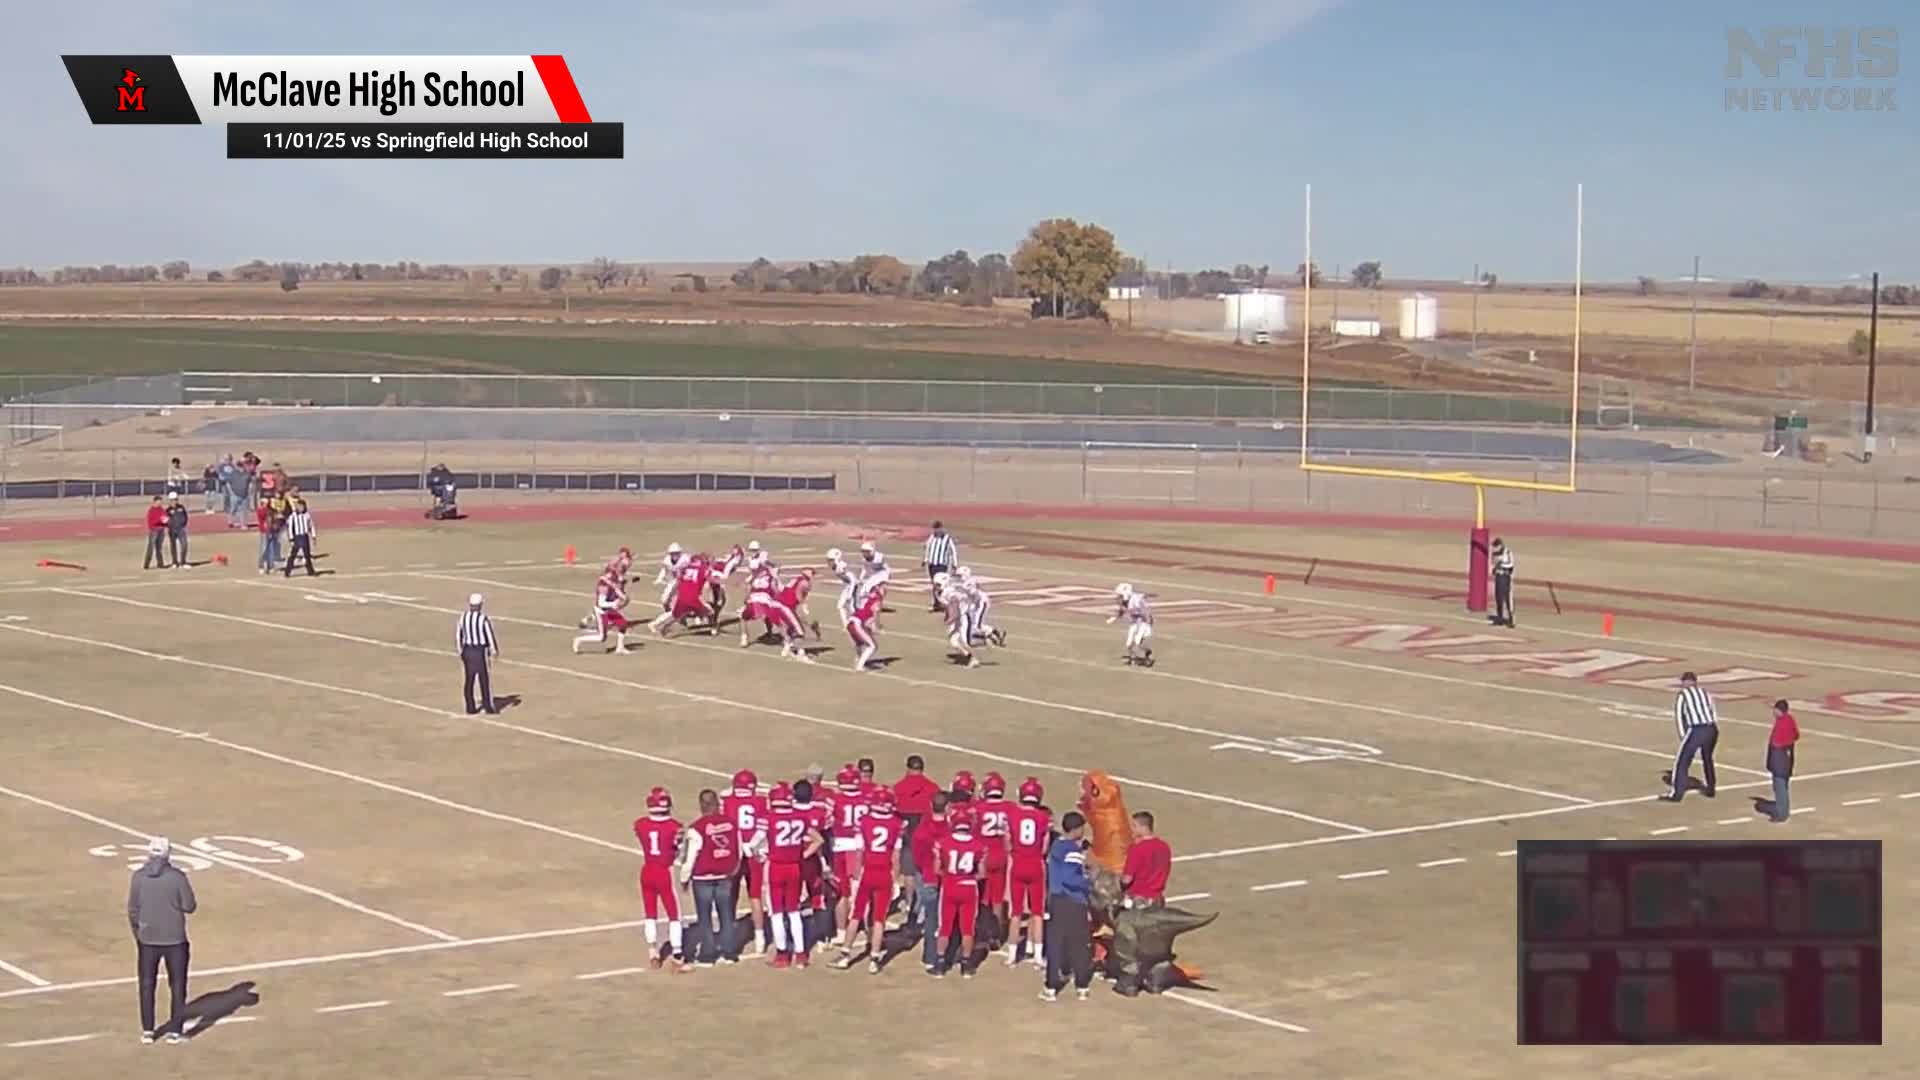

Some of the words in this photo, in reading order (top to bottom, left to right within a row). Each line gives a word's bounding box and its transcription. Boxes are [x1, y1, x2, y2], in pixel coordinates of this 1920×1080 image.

[738, 804, 756, 831] 6
[649, 831, 661, 856] 1
[775, 820, 807, 848] 22
[871, 826, 889, 853] 2
[1019, 818, 1036, 846] 8
[948, 849, 975, 875] 14
